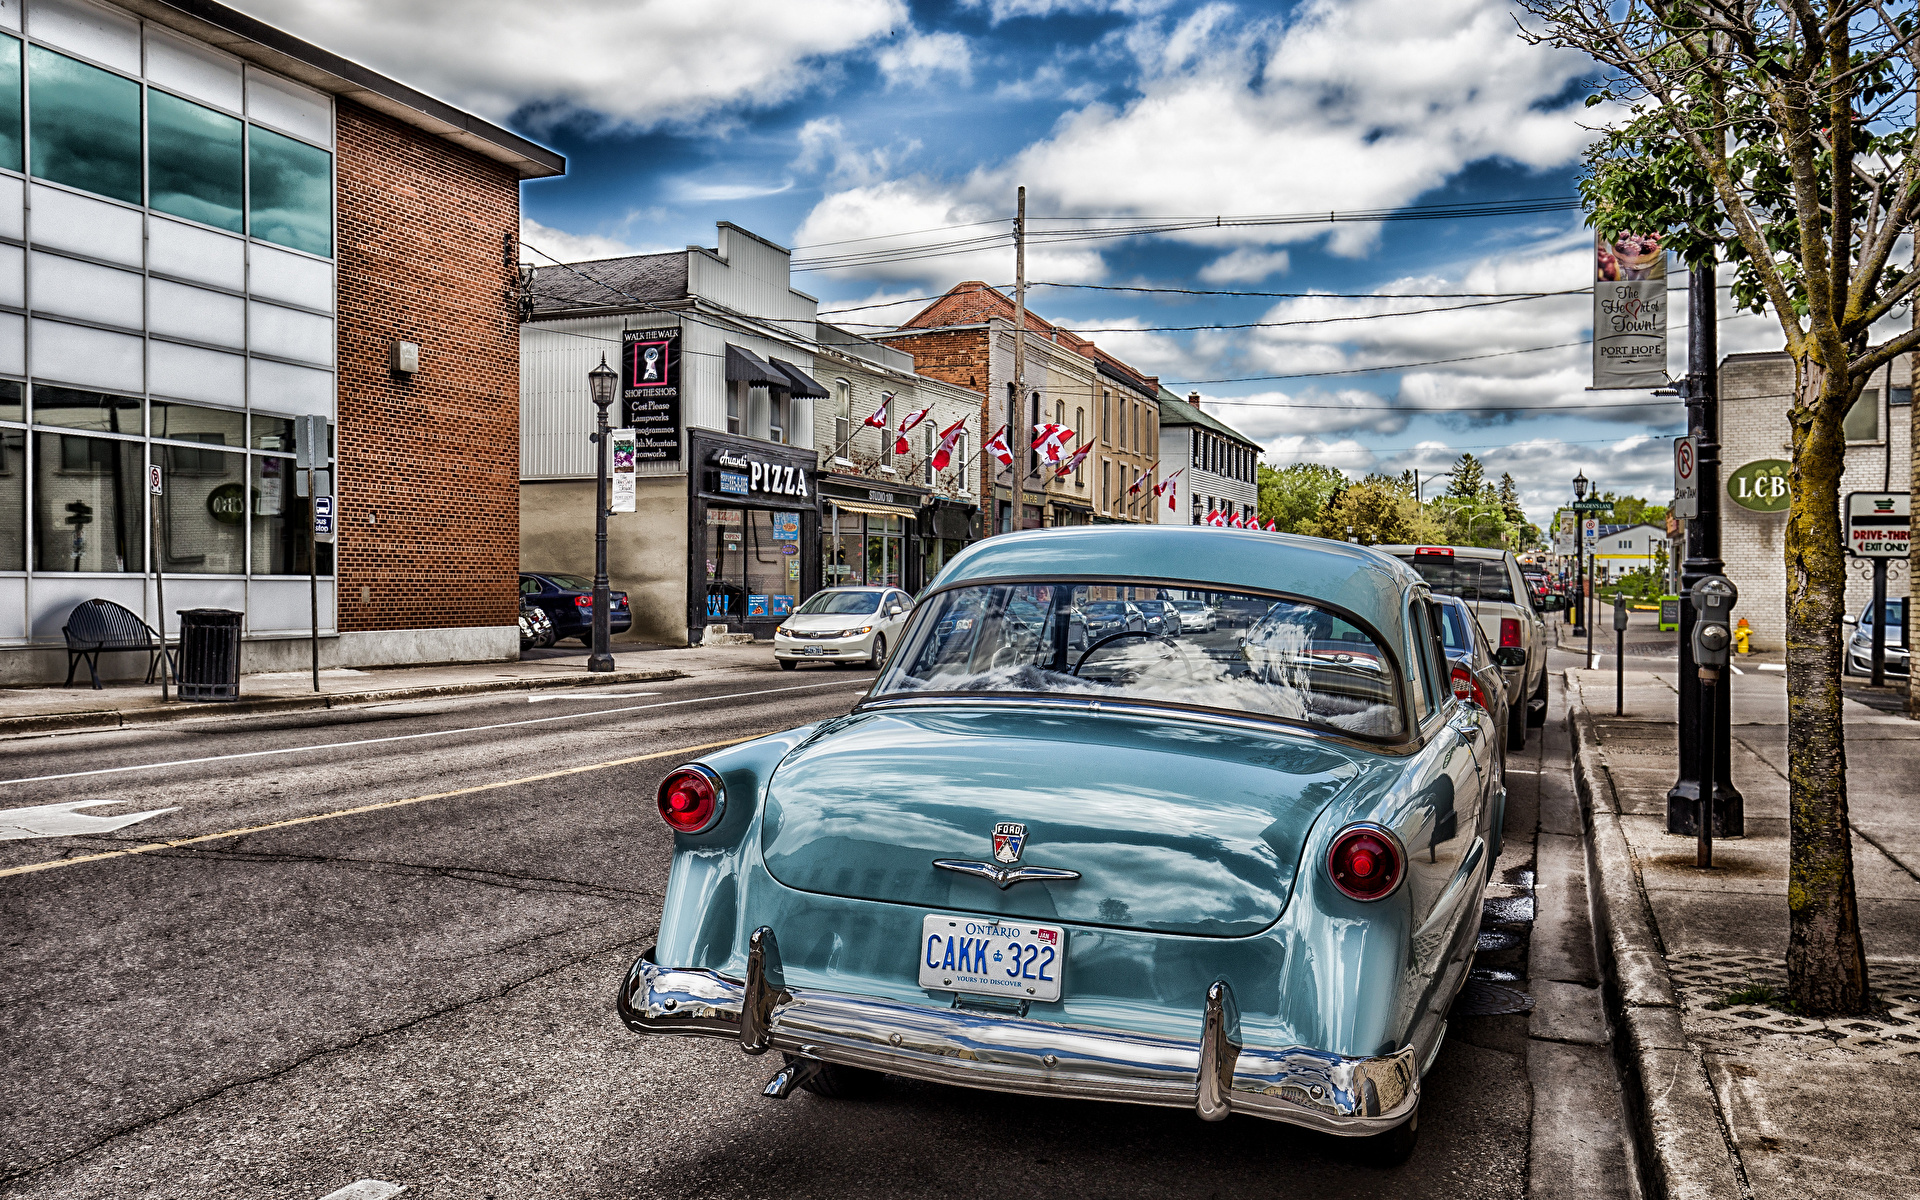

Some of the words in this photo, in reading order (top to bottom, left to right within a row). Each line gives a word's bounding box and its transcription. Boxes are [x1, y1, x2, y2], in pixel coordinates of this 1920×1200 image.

[1616, 286, 1639, 299] The
[1651, 301, 1660, 312] of
[1611, 314, 1657, 332] Town!
[624, 332, 645, 341] WALK
[645, 331, 658, 339] THE
[658, 329, 679, 338] WALK
[1600, 346, 1628, 356] PORT
[1631, 344, 1661, 355] HOPE
[624, 389, 643, 398] SHOP
[643, 388, 654, 397] THE
[654, 387, 677, 396] SHOPS
[631, 412, 669, 424] Lampworks
[646, 438, 678, 448] Mountain
[750, 461, 808, 497] PIZZA
[1738, 476, 1791, 498] LCB
[868, 490, 886, 502] STUDIO
[710, 510, 740, 521] PIZZA
[315, 525, 329, 533] stop
[1865, 542, 1883, 552] EXIT
[1884, 542, 1909, 552] ONLY
[997, 825, 1021, 835] FORD
[965, 922, 1021, 939] ONTARIO
[926, 933, 991, 975] CAKK
[1006, 942, 1055, 982] 322
[956, 975, 978, 983] YOURS
[990, 979, 1022, 987] DISCOVER
